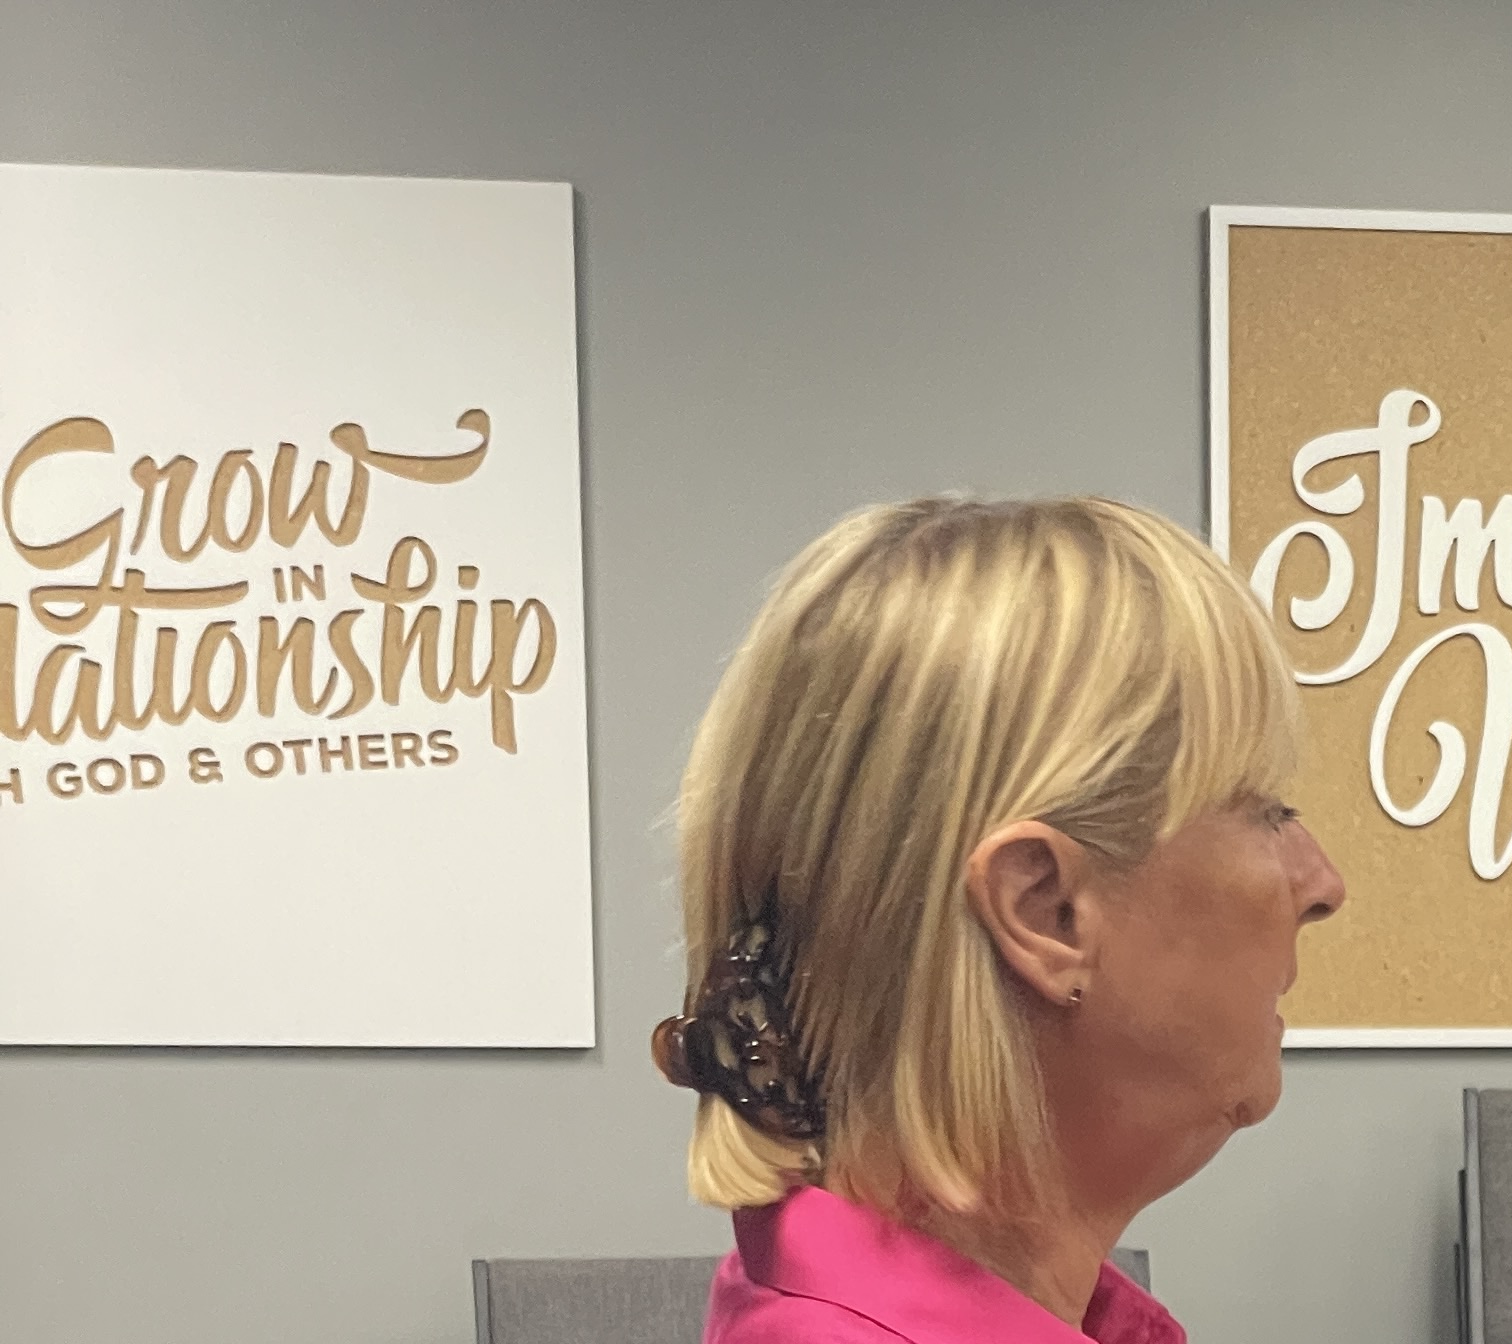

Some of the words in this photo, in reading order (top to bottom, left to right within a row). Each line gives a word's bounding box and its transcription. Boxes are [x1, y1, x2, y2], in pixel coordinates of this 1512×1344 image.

[2, 408, 491, 634] Grow
[271, 563, 326, 603] IN
[46, 752, 166, 800] GOD
[188, 746, 224, 784] &
[244, 729, 460, 779] OTHERS
